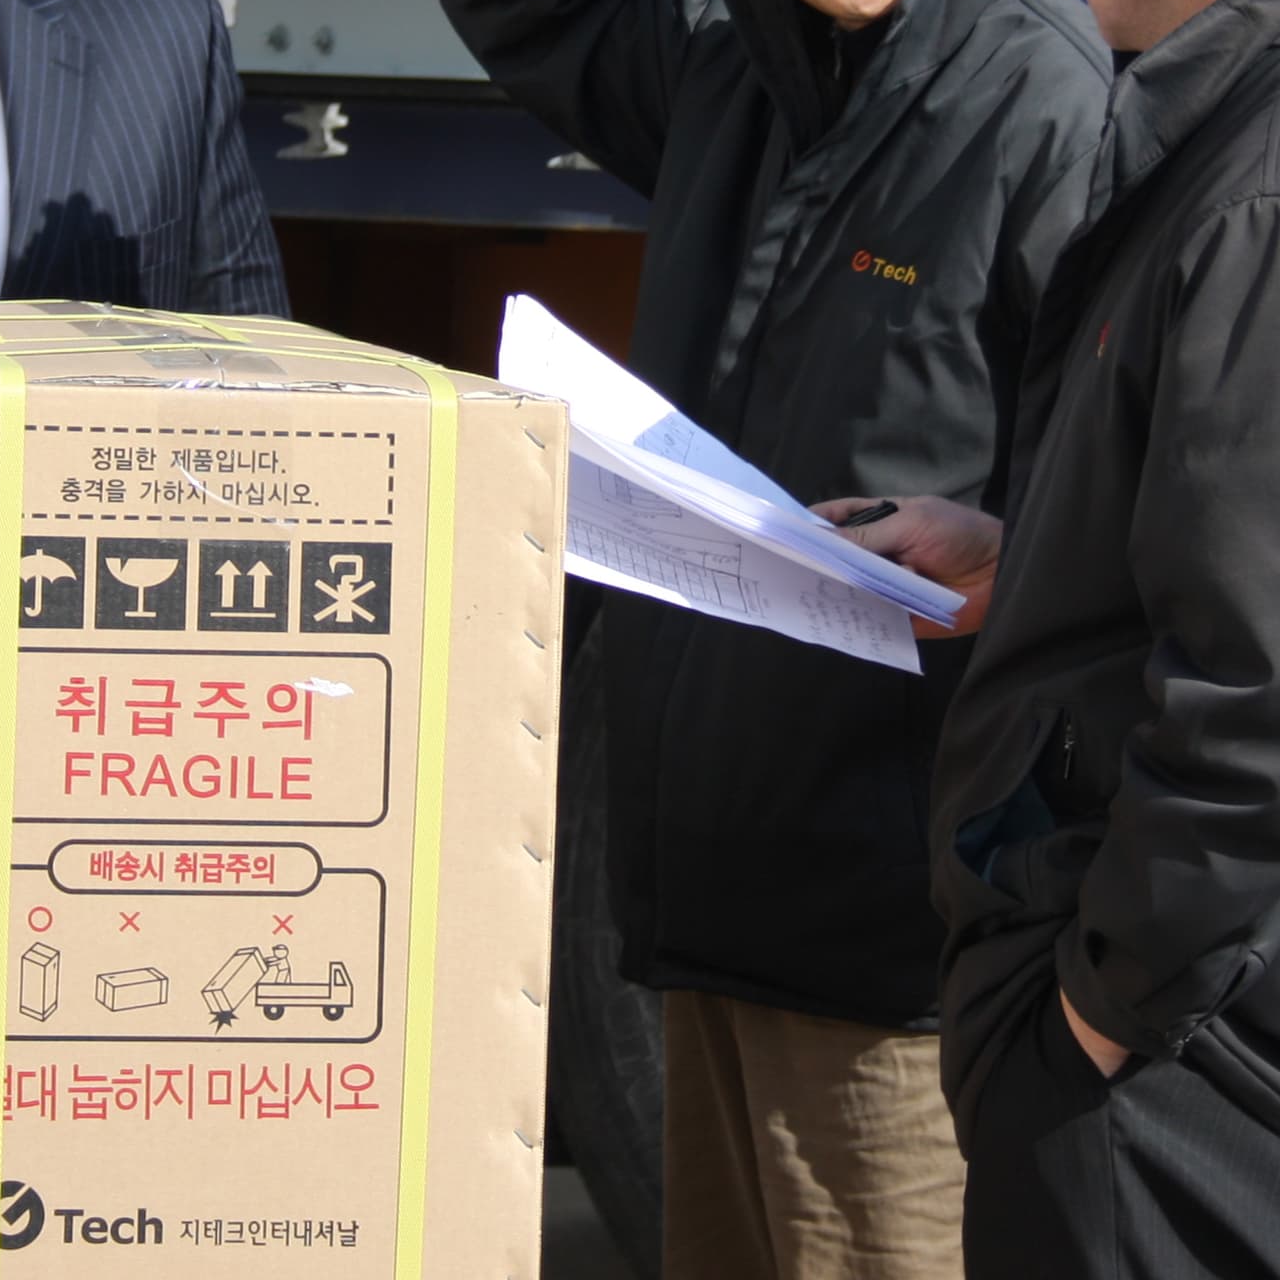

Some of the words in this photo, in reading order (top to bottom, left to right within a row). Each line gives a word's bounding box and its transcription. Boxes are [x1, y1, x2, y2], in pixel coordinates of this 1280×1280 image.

[872, 257, 917, 286] Tech
[92, 447, 156, 471] 정밀한
[171, 449, 285, 474] 제품입니다.
[61, 478, 126, 502] 충격을
[140, 480, 206, 504] 가하지
[222, 482, 319, 506] 마십시오.
[56, 677, 312, 740] 취급주의
[65, 752, 312, 800] FRAGILE
[90, 852, 164, 881] 배송시
[176, 853, 275, 883] 취급주의
[68, 1065, 194, 1120] 눕히지
[208, 1064, 380, 1119] 마십시오
[54, 1208, 163, 1244] Tech
[180, 1220, 359, 1247] 지테크인터내셔날
